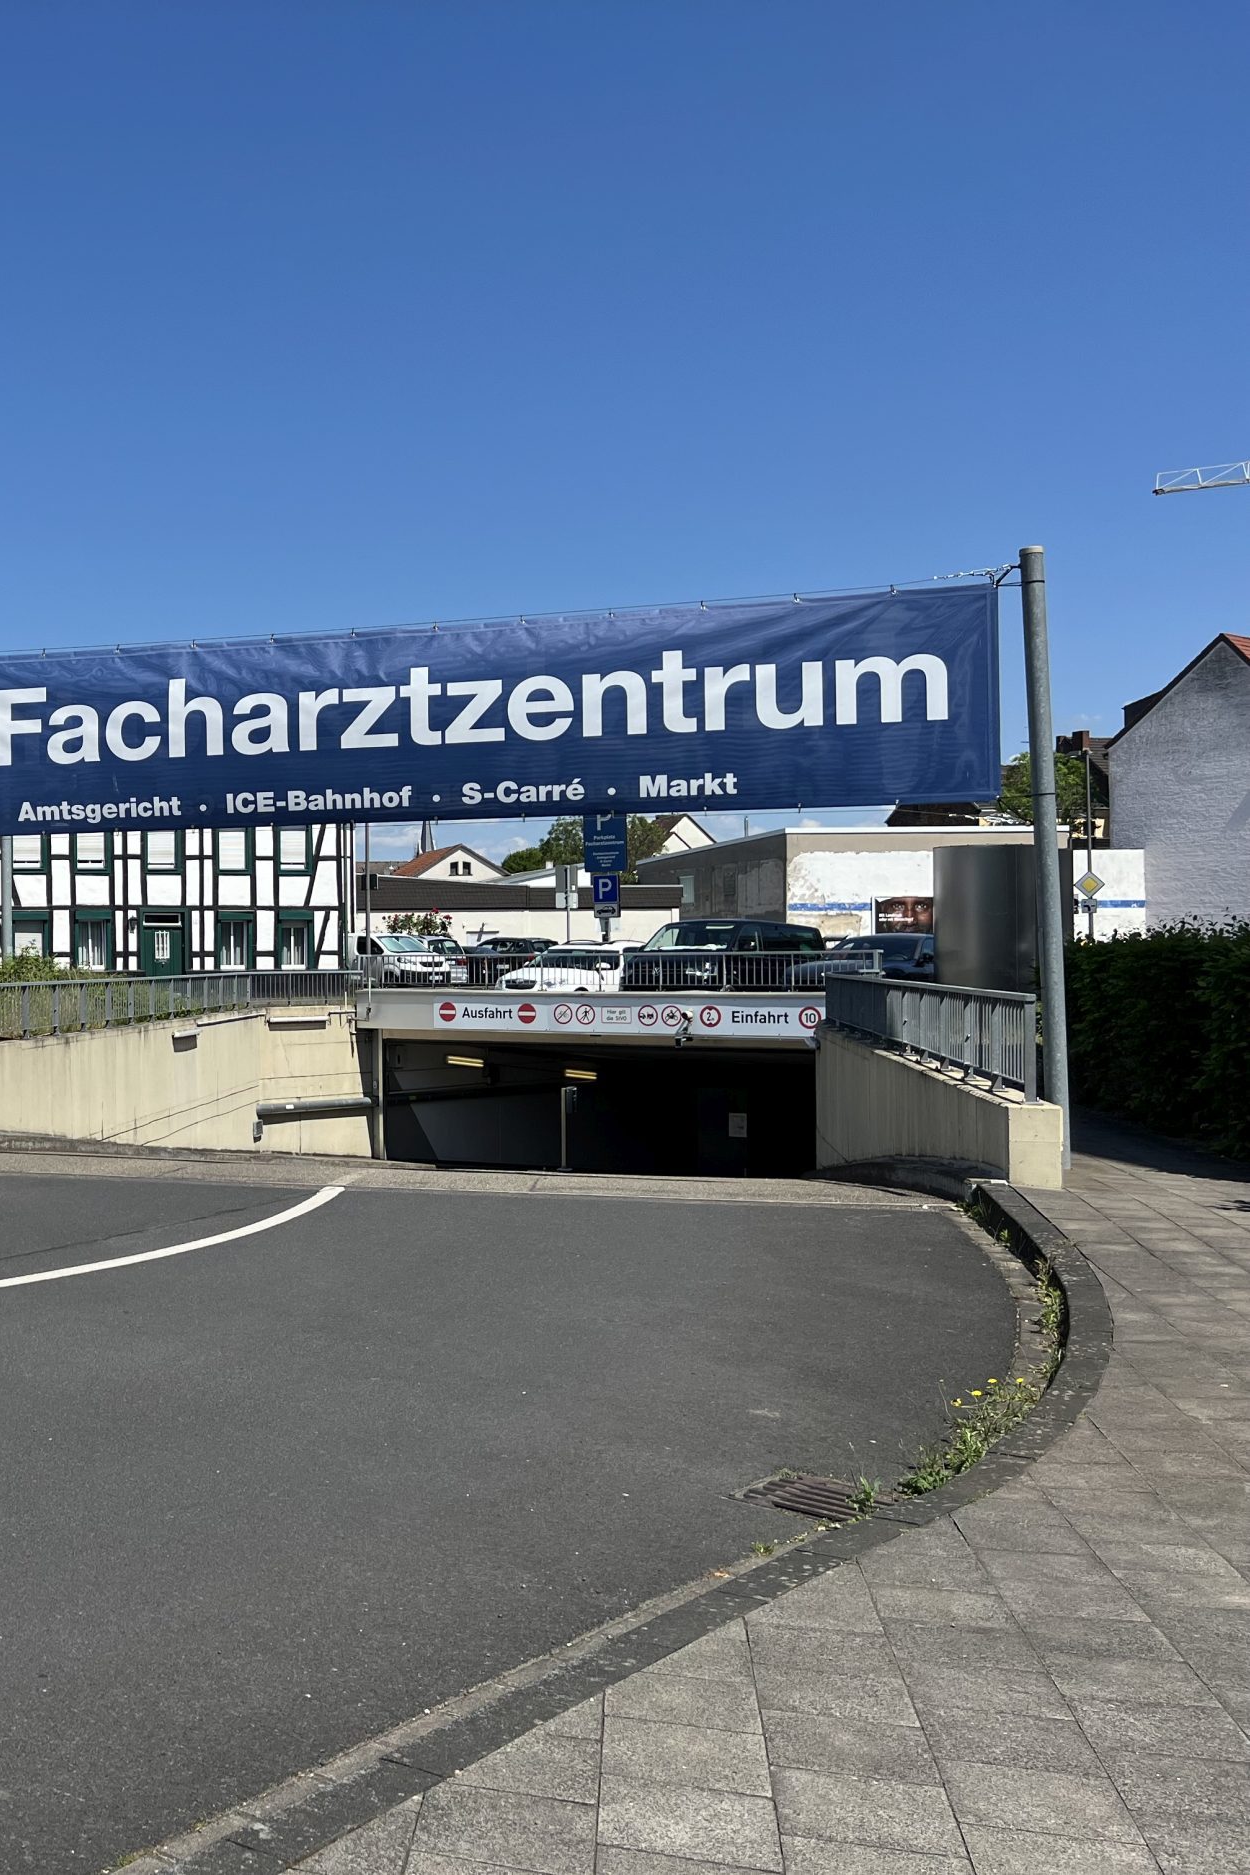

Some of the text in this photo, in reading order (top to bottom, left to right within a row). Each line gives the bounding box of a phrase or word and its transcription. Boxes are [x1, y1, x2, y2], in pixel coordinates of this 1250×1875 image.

[18, 772, 738, 823] Amtsgericht ICE-Bahnhof S-Carré Markt
[598, 878, 612, 899] P
[462, 1006, 513, 1019] Ausfahrt
[732, 1010, 789, 1024] Einfahrt
[805, 1012, 816, 1023] 10
